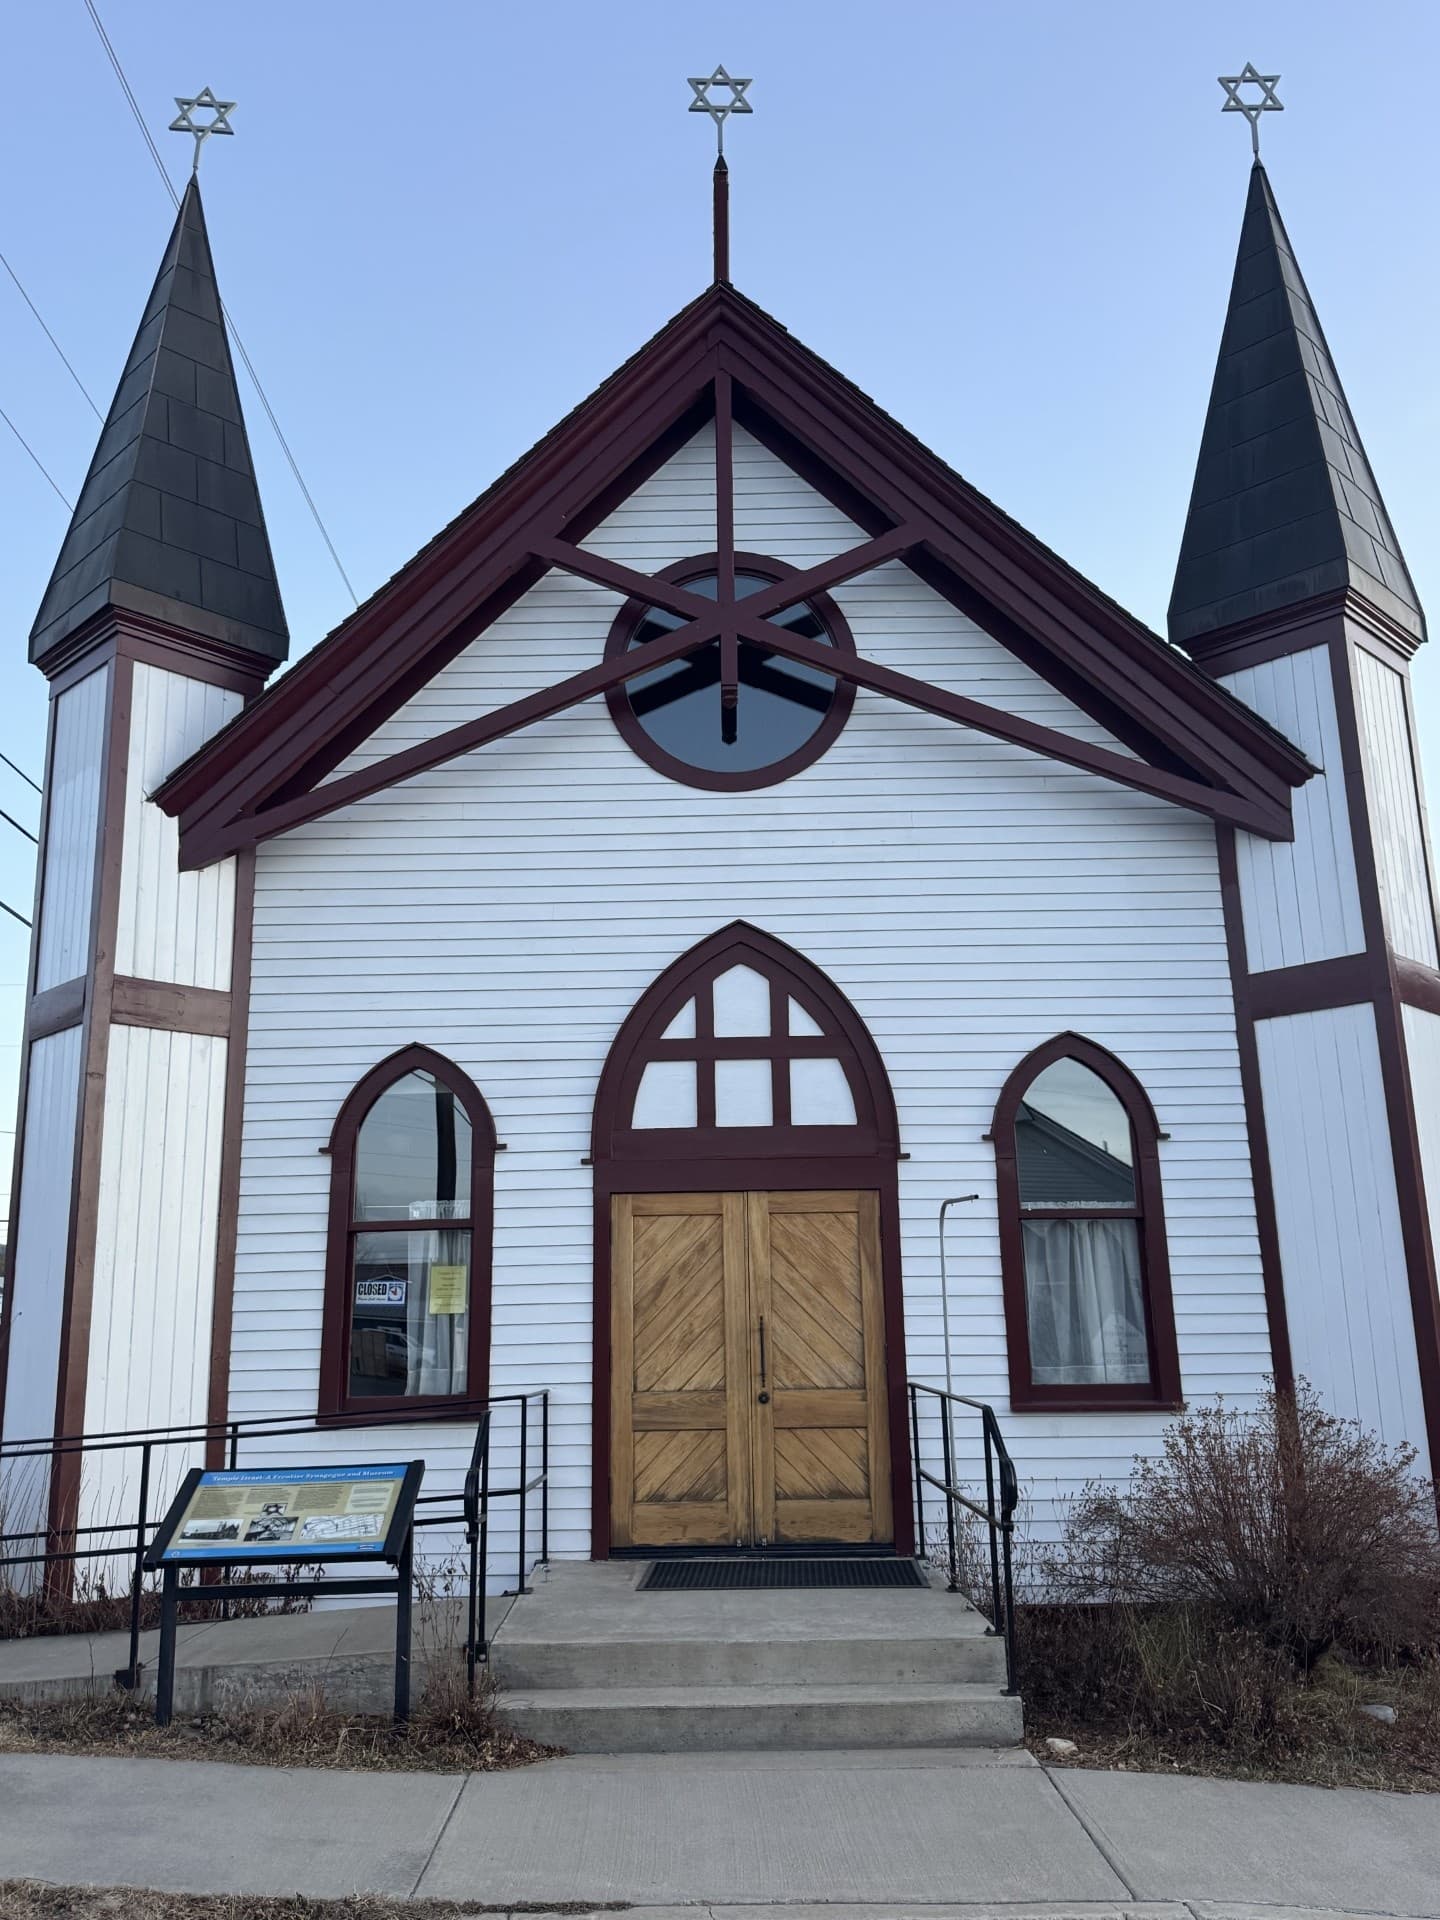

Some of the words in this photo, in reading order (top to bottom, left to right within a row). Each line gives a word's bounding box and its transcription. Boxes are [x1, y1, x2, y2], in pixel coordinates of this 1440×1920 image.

[358, 1283, 388, 1296] CLOSED
[213, 1474, 239, 1482] Temple
[272, 1472, 305, 1480] Frontier
[305, 1472, 346, 1480] Synagogue
